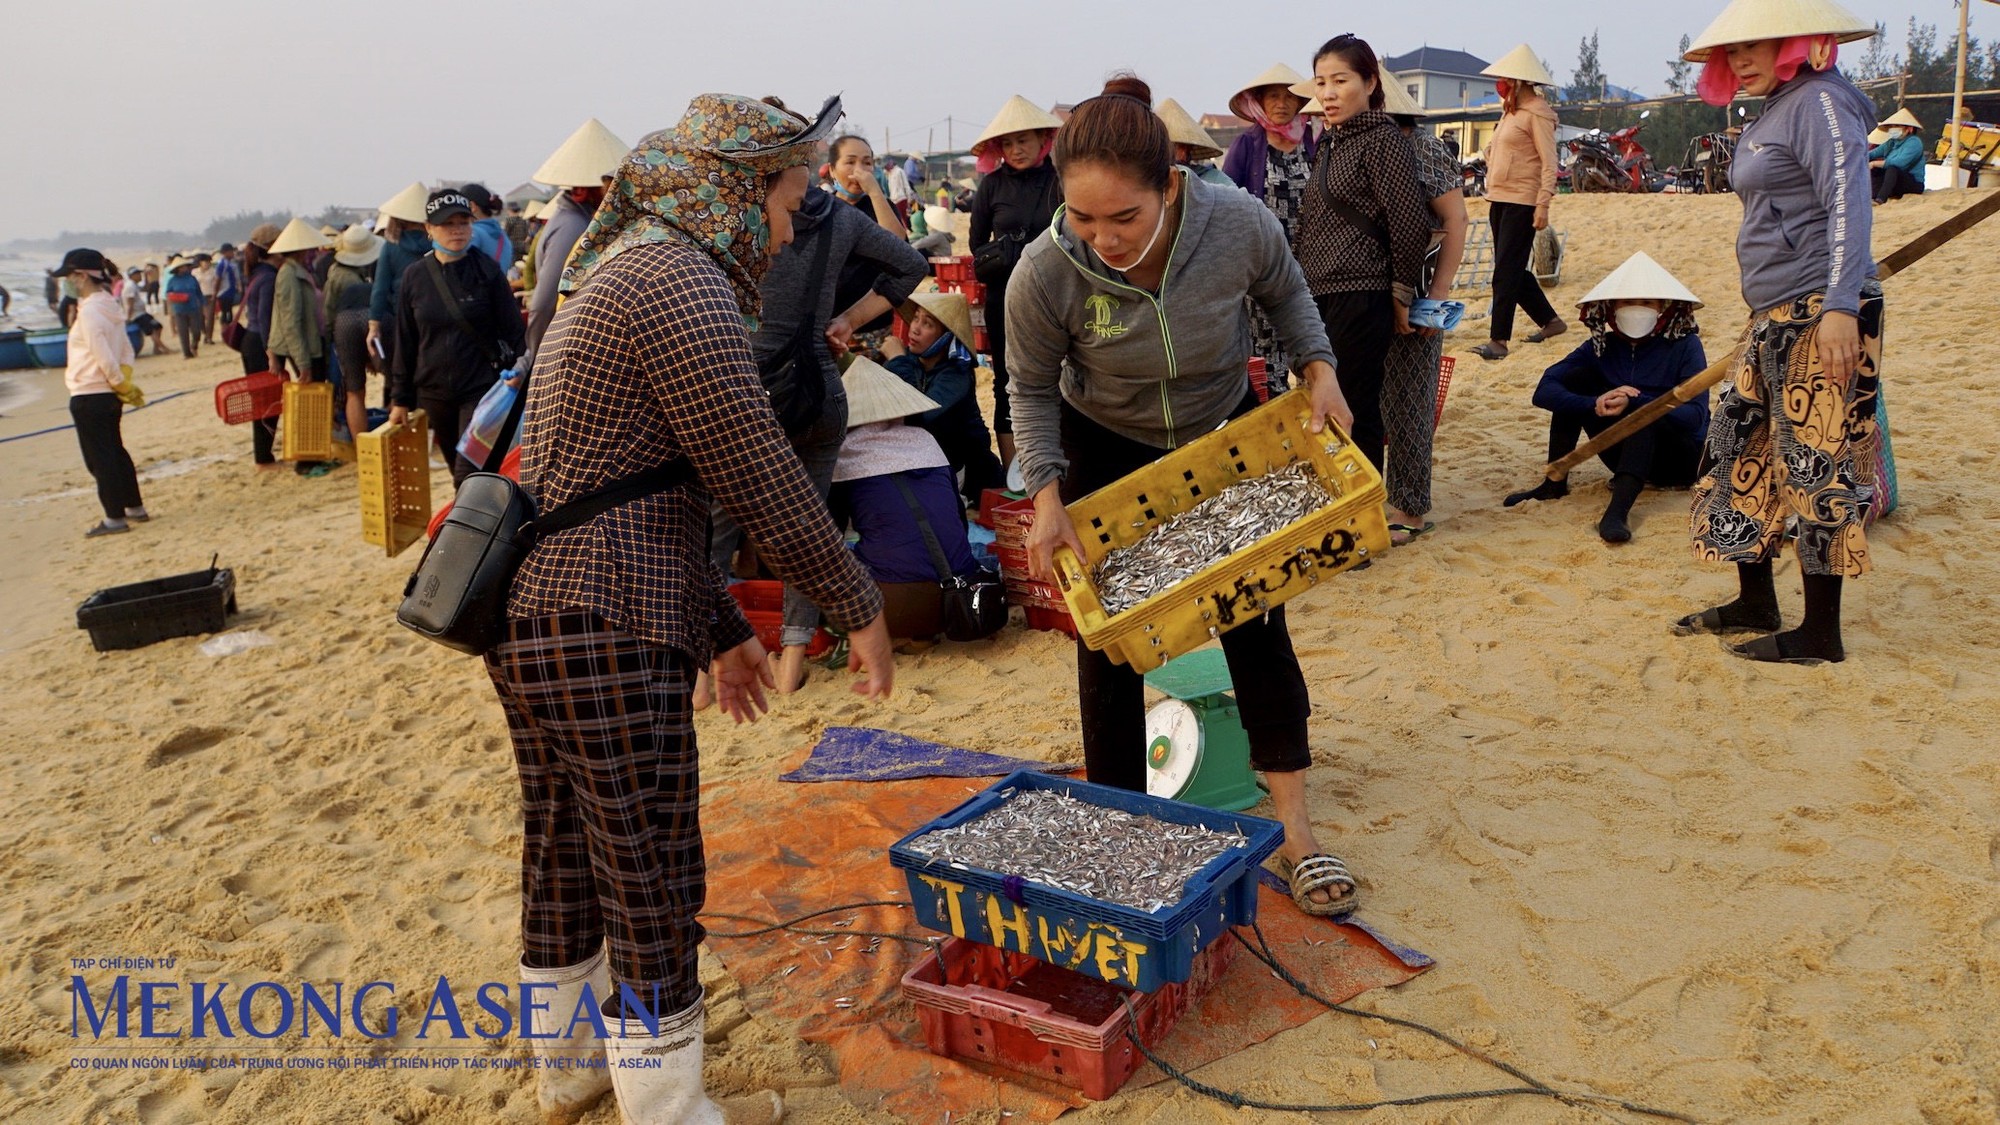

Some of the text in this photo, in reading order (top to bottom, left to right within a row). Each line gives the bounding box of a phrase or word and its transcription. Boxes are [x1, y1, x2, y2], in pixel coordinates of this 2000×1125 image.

[1819, 91, 1841, 138] mischiefe
[1834, 140, 1846, 167] Miss
[1834, 217, 1846, 242] Miss
